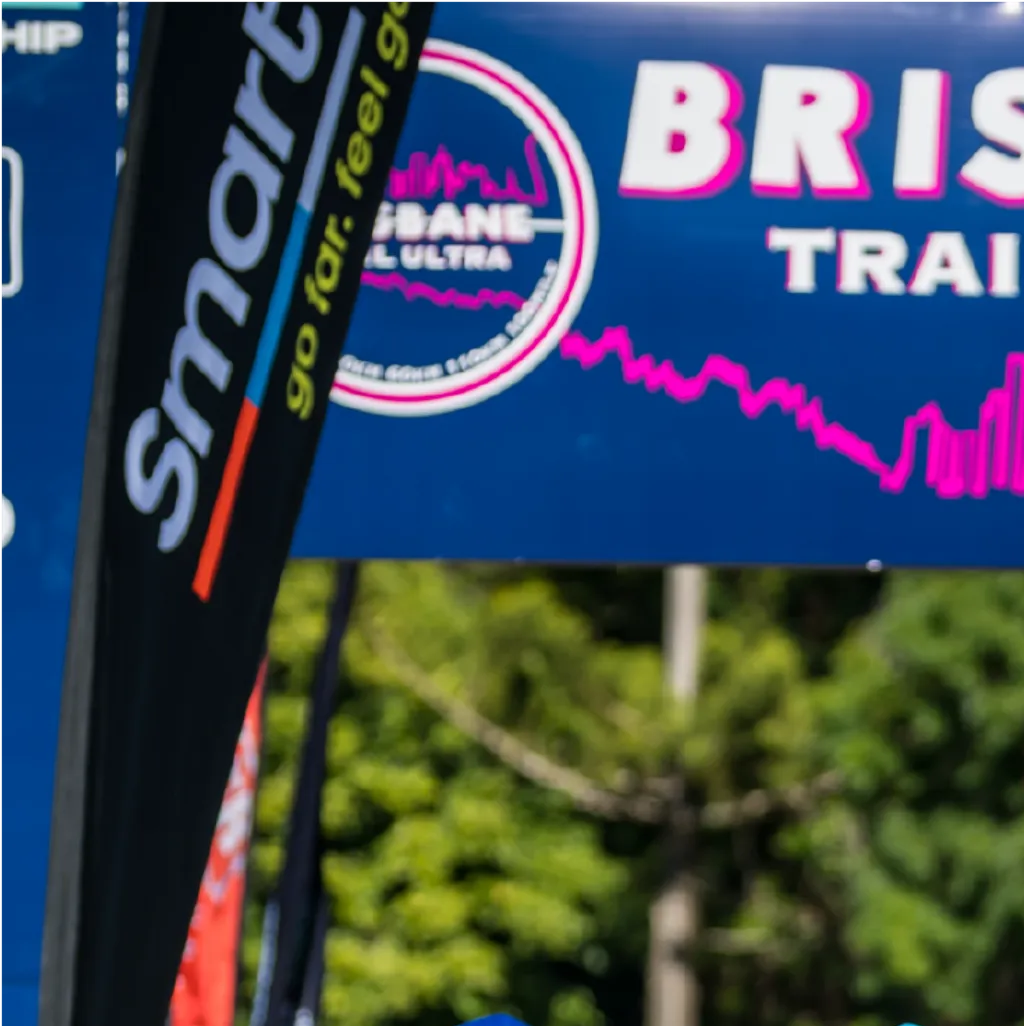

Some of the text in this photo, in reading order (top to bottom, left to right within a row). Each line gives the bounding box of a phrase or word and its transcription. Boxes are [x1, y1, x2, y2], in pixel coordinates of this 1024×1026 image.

[286, 323, 318, 420] go
[335, 64, 390, 199] feel
[400, 244, 513, 271] ULTRA
